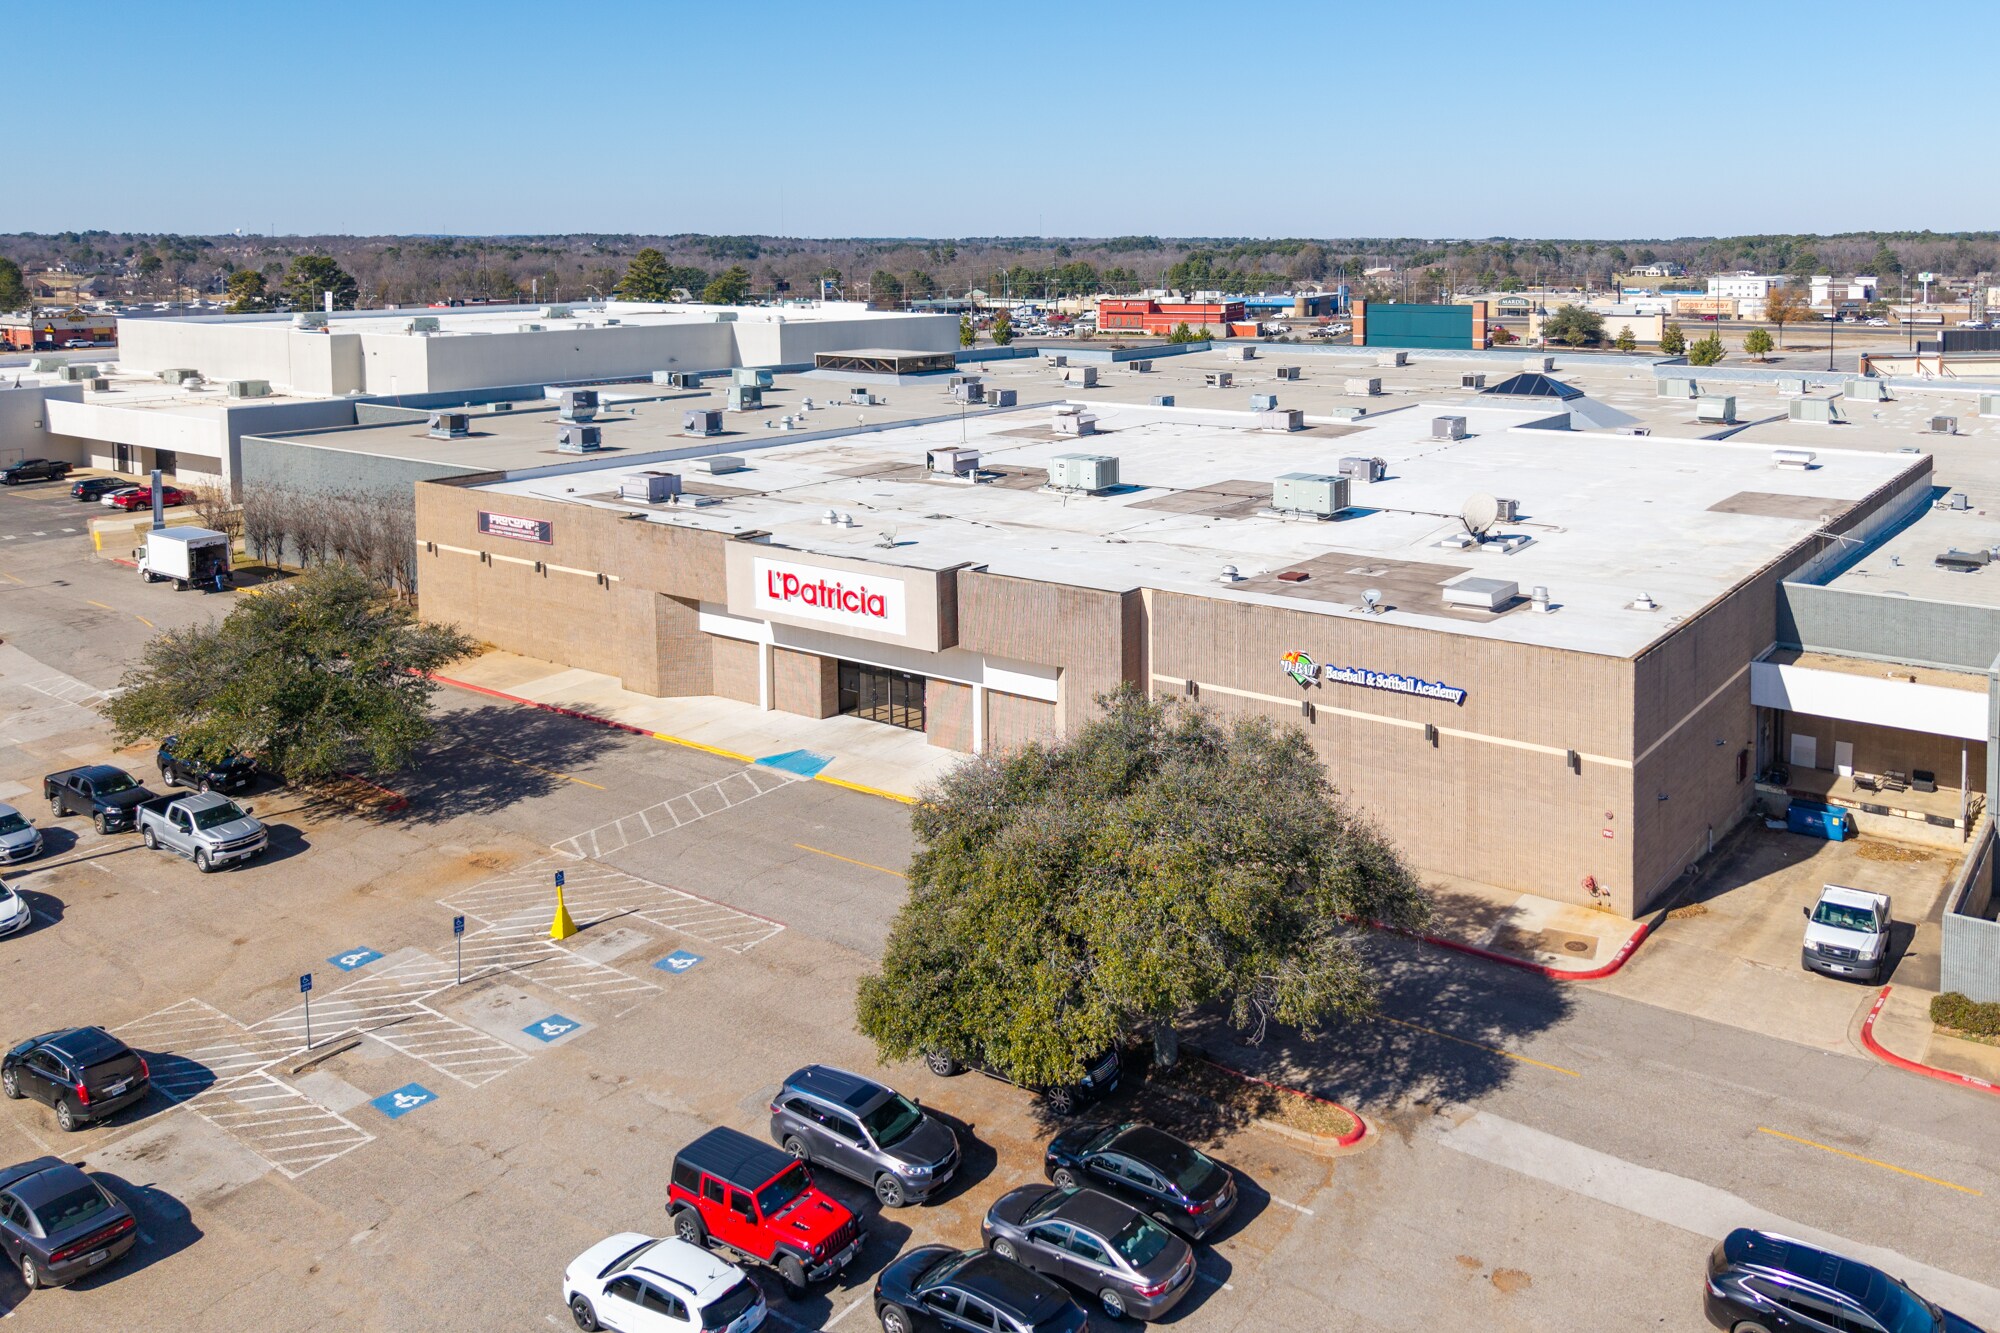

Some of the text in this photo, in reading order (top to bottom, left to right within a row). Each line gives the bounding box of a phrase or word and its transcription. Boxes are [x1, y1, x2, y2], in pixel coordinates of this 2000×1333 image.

[768, 569, 887, 618] L'Patricia
[1325, 666, 1463, 703] Baseball & Softball Academy
